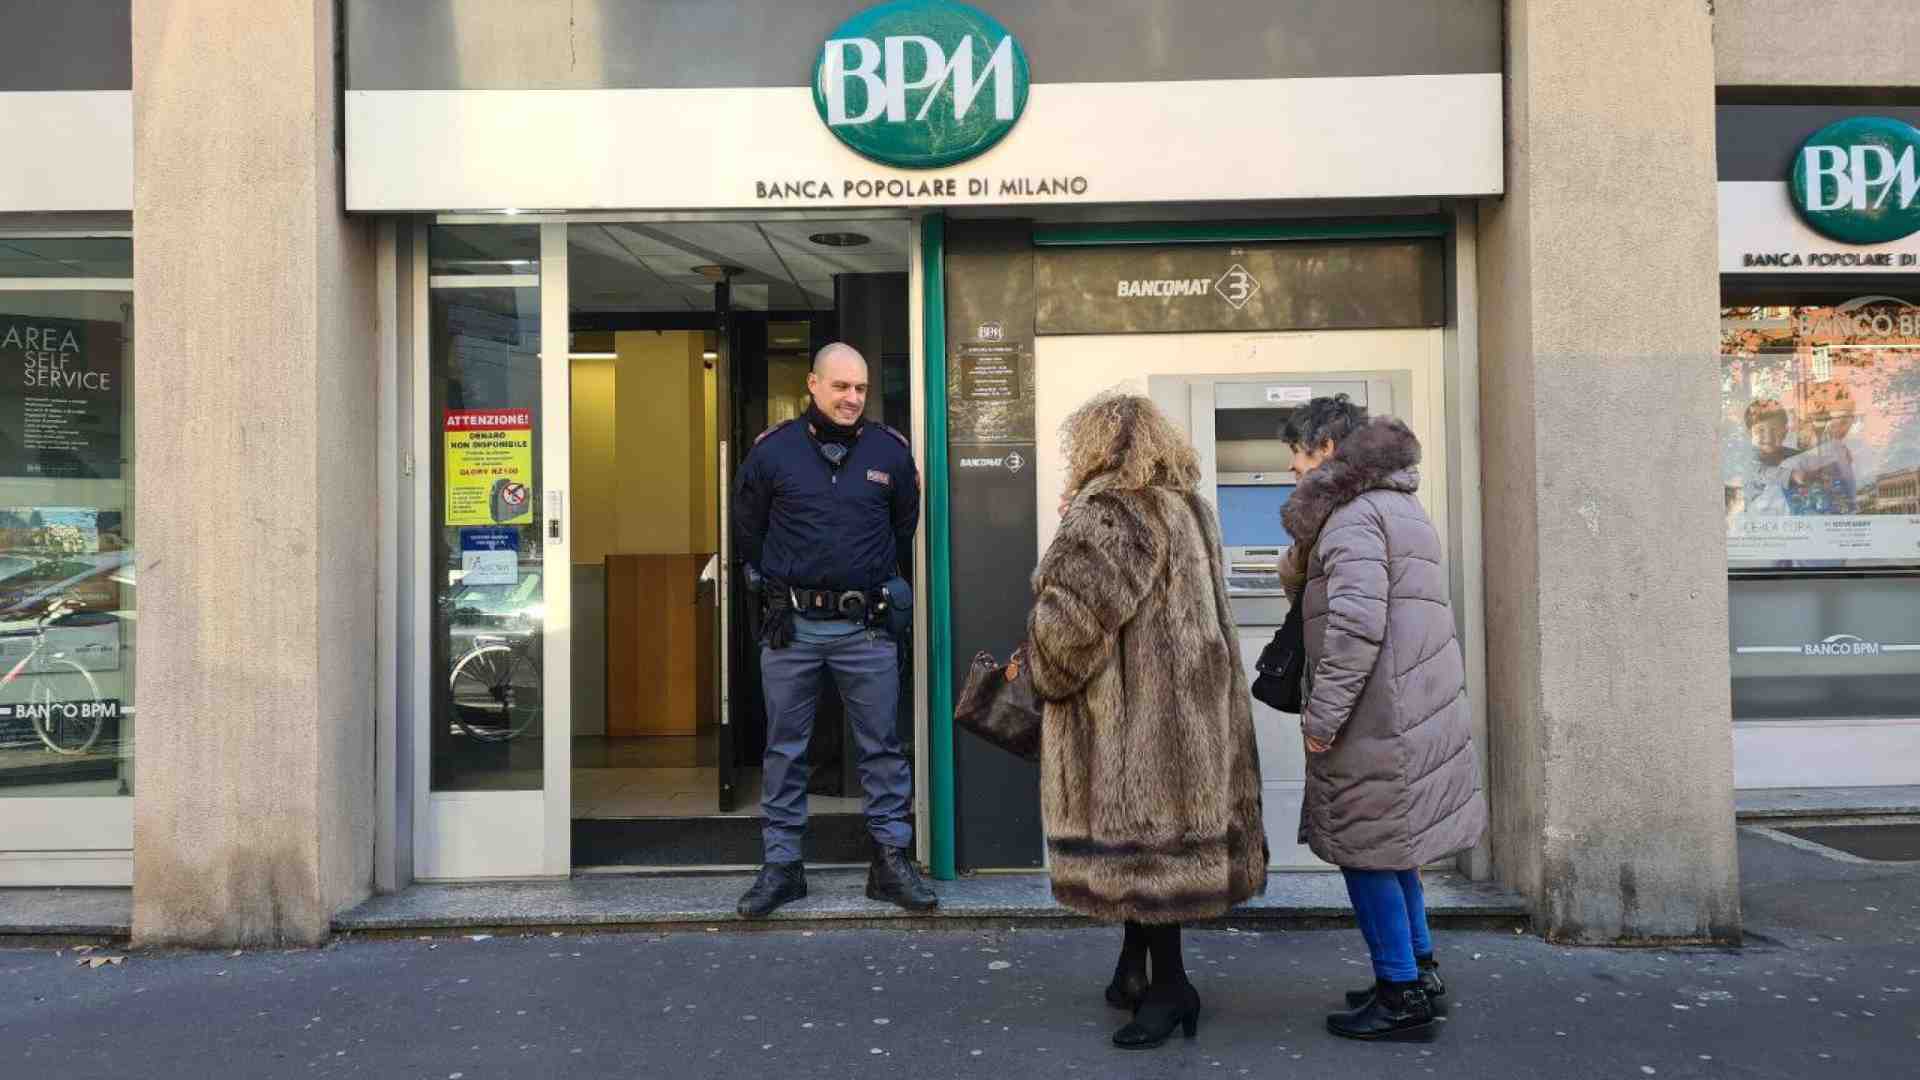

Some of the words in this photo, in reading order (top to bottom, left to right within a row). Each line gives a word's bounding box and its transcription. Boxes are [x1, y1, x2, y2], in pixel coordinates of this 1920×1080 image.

[824, 35, 1015, 126] BPM
[755, 180, 833, 199] BANCA
[843, 179, 957, 198] POPOLARE
[968, 178, 989, 197] DI
[999, 176, 1089, 197] MILANO
[1744, 252, 1803, 268] BANCA
[1808, 252, 1891, 268] POPOLARE
[1900, 253, 1917, 267] DI
[1117, 278, 1212, 298] BANCOMAT
[1, 325, 81, 353] AREA
[23, 350, 71, 371] SELF
[23, 369, 112, 392] SERVICE
[447, 414, 530, 426] ATTENZIONE!
[450, 441, 470, 449] NON
[472, 440, 528, 449] DISPONIBILE
[959, 457, 1003, 468] BANCOMAT
[1804, 642, 1851, 656] BANCO
[1853, 641, 1879, 657] BPM
[81, 702, 117, 718] BPM
